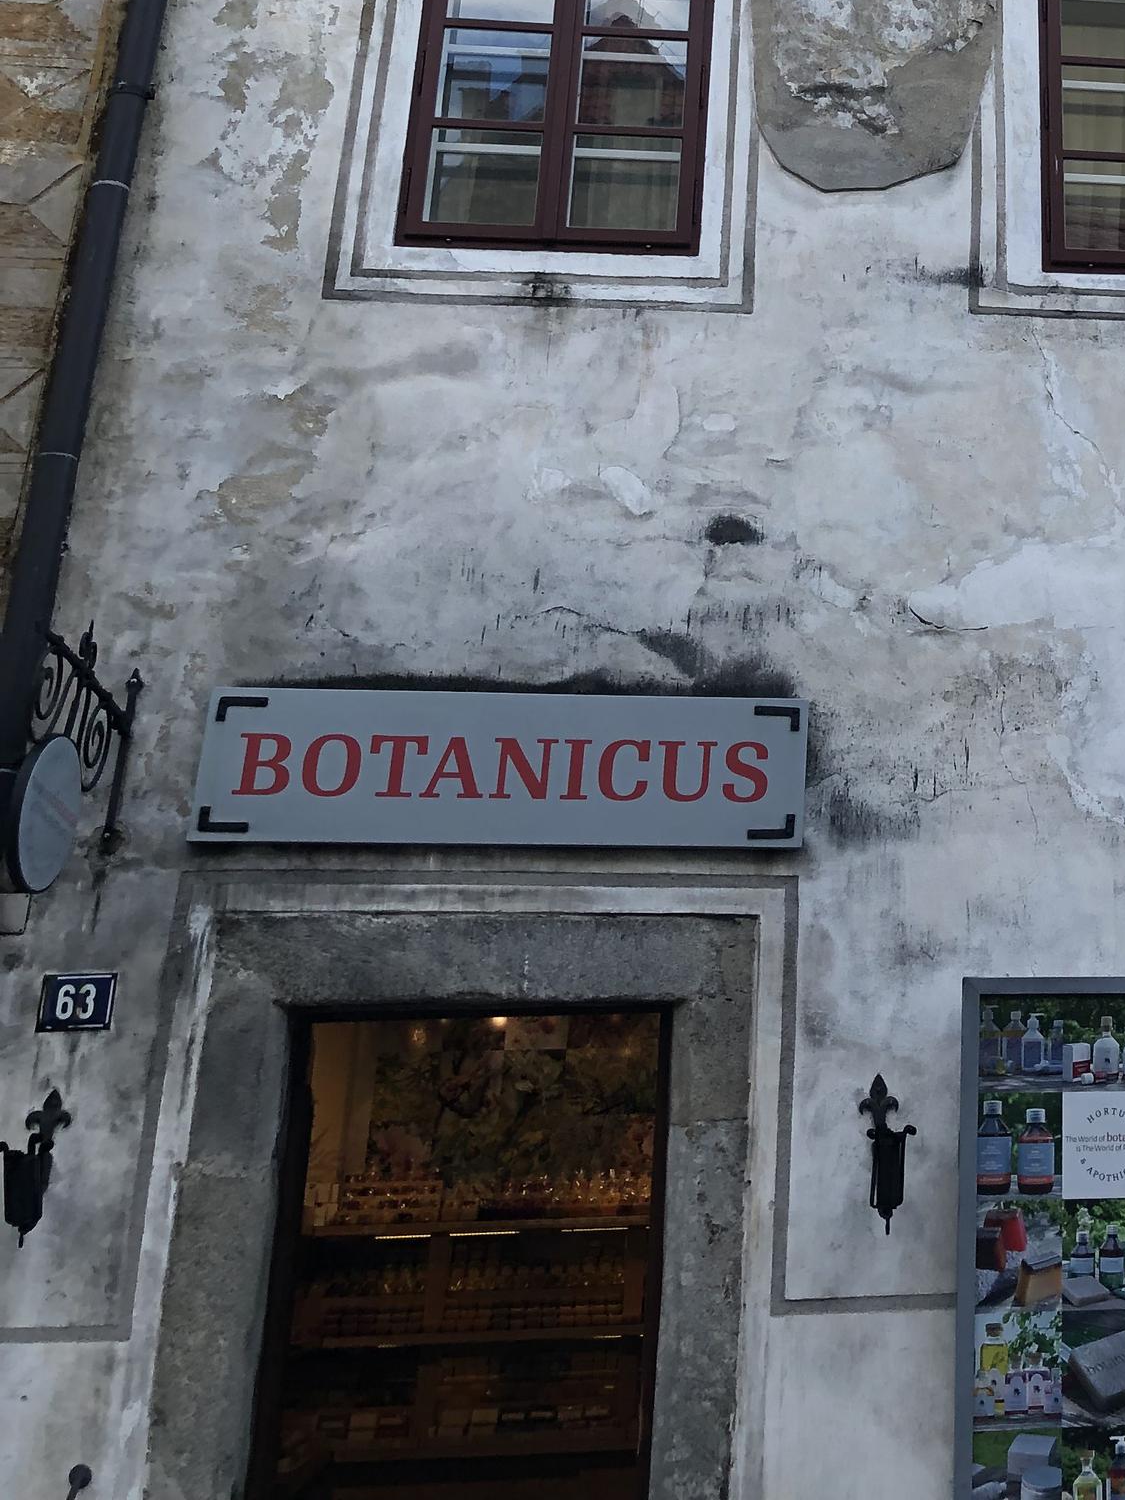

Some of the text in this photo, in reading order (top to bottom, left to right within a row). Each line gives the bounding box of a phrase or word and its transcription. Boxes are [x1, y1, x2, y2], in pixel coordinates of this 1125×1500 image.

[231, 732, 770, 803] BOTANICUS
[55, 983, 97, 1021] 63
[1065, 1135, 1077, 1143] The
[1077, 1135, 1098, 1143] World
[1081, 1144, 1094, 1152] The
[1094, 1144, 1115, 1152] World
[1115, 1143, 1122, 1151] of
